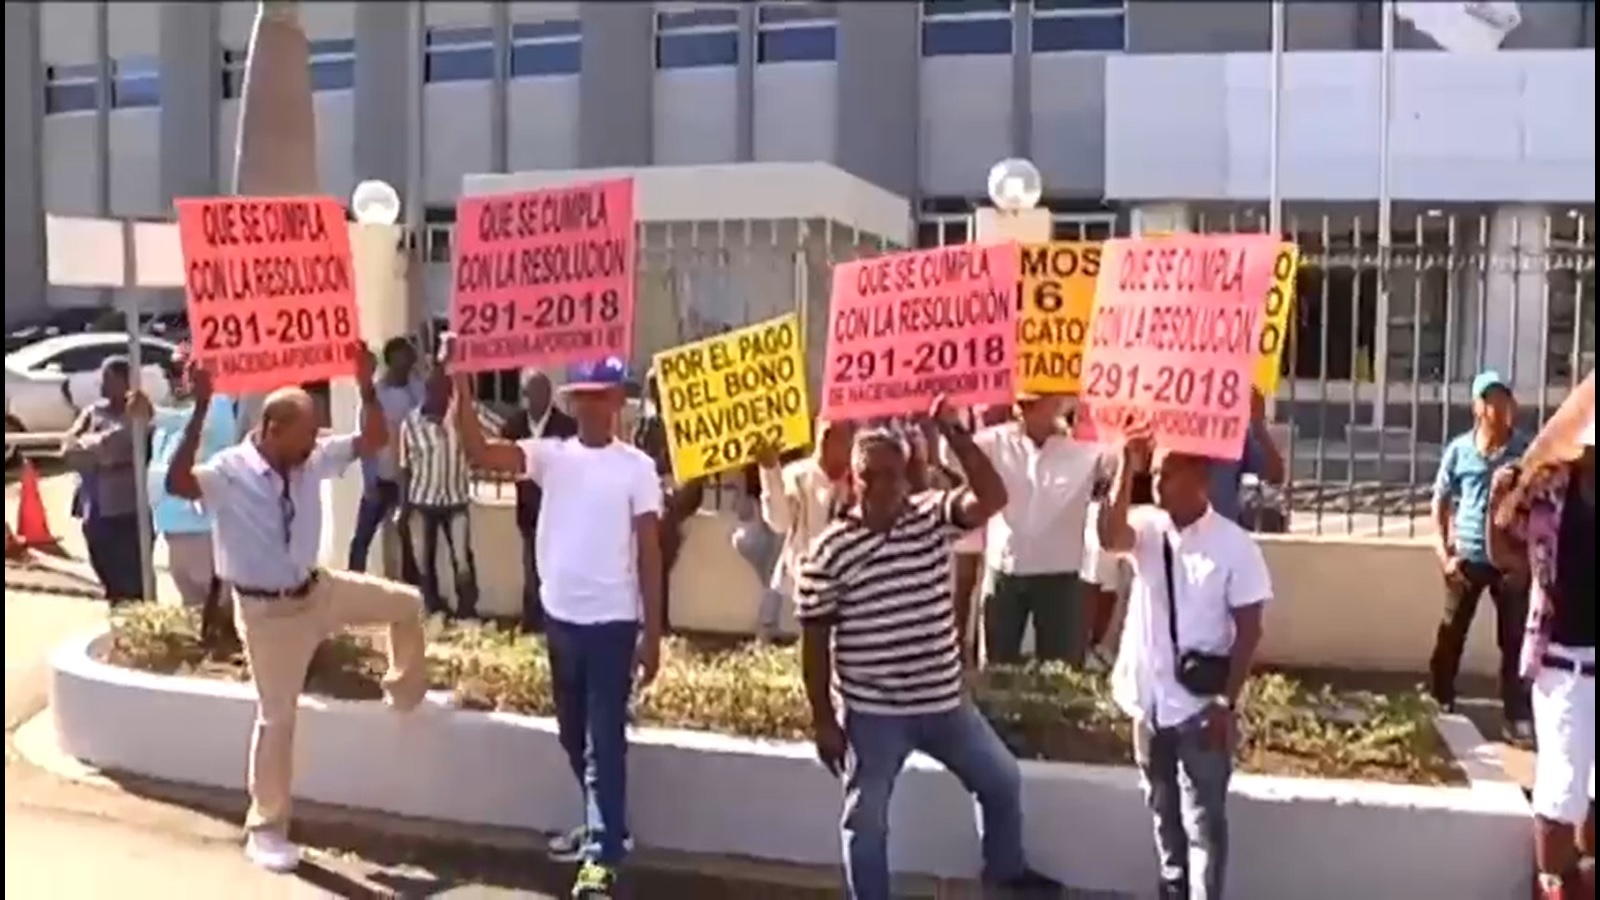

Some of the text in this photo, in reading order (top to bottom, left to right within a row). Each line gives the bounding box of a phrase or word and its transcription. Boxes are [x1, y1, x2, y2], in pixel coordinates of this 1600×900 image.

[202, 202, 328, 245] QUE SE CUMPLA
[479, 191, 608, 242] QUE SE CUMPLA
[190, 260, 228, 302] CON
[229, 258, 253, 299] LA
[458, 254, 492, 292] CON
[495, 251, 517, 289] LA
[857, 248, 991, 297] QUE SE CUMPLA
[1119, 248, 1246, 293] QUE SE CUMPLA
[201, 305, 351, 350] 291-2018
[458, 289, 619, 335] 291-2018
[834, 306, 870, 344] CON
[873, 303, 895, 336] LA
[1015, 317, 1089, 345] ICATO
[1124, 306, 1146, 348] LA
[661, 322, 793, 383] POR EL PAGO
[834, 334, 1004, 383] 291-2018
[668, 354, 794, 412] DEL BONO
[1087, 362, 1241, 409] 291-2018
[701, 424, 786, 470] 2022
